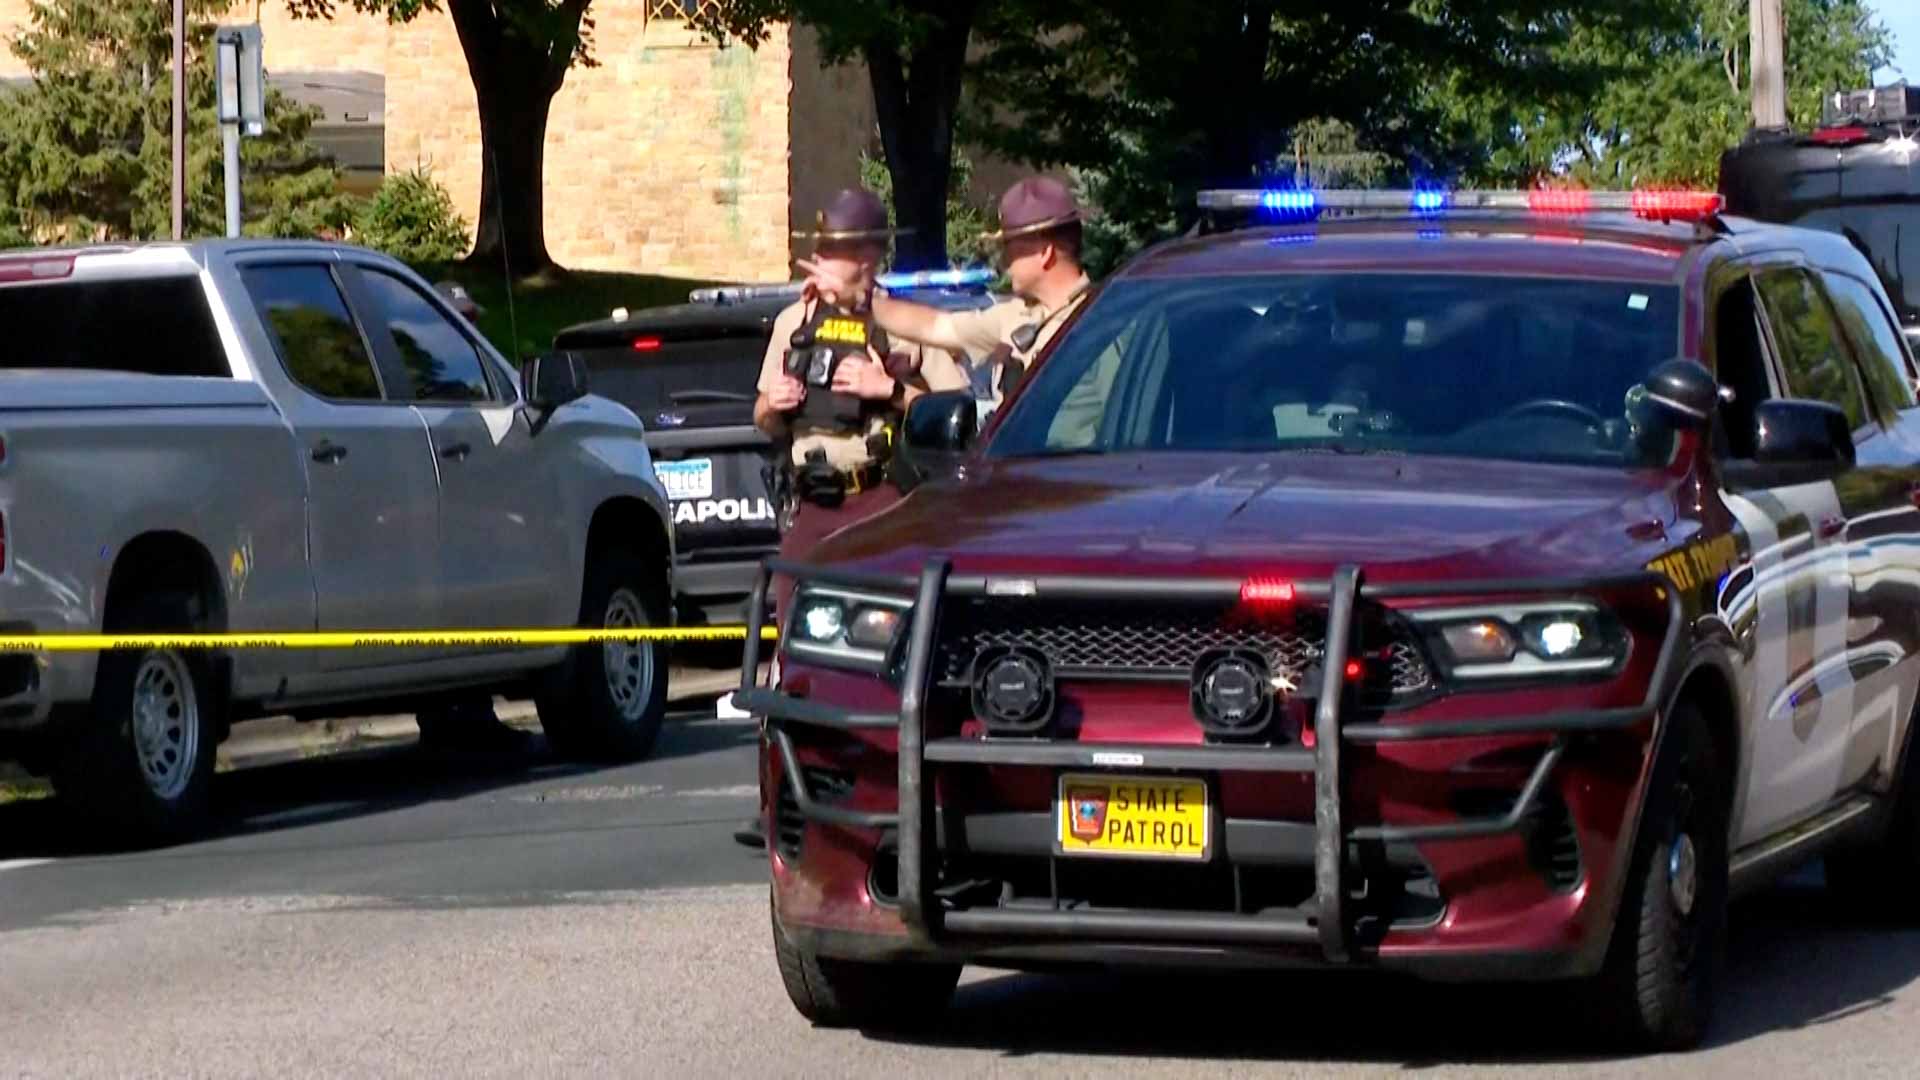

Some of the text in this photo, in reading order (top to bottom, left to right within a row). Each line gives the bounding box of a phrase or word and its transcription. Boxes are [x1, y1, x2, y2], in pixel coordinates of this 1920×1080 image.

[669, 497, 777, 525] APOLI
[1116, 786, 1187, 814] STATE
[1109, 819, 1201, 847] PATROL
